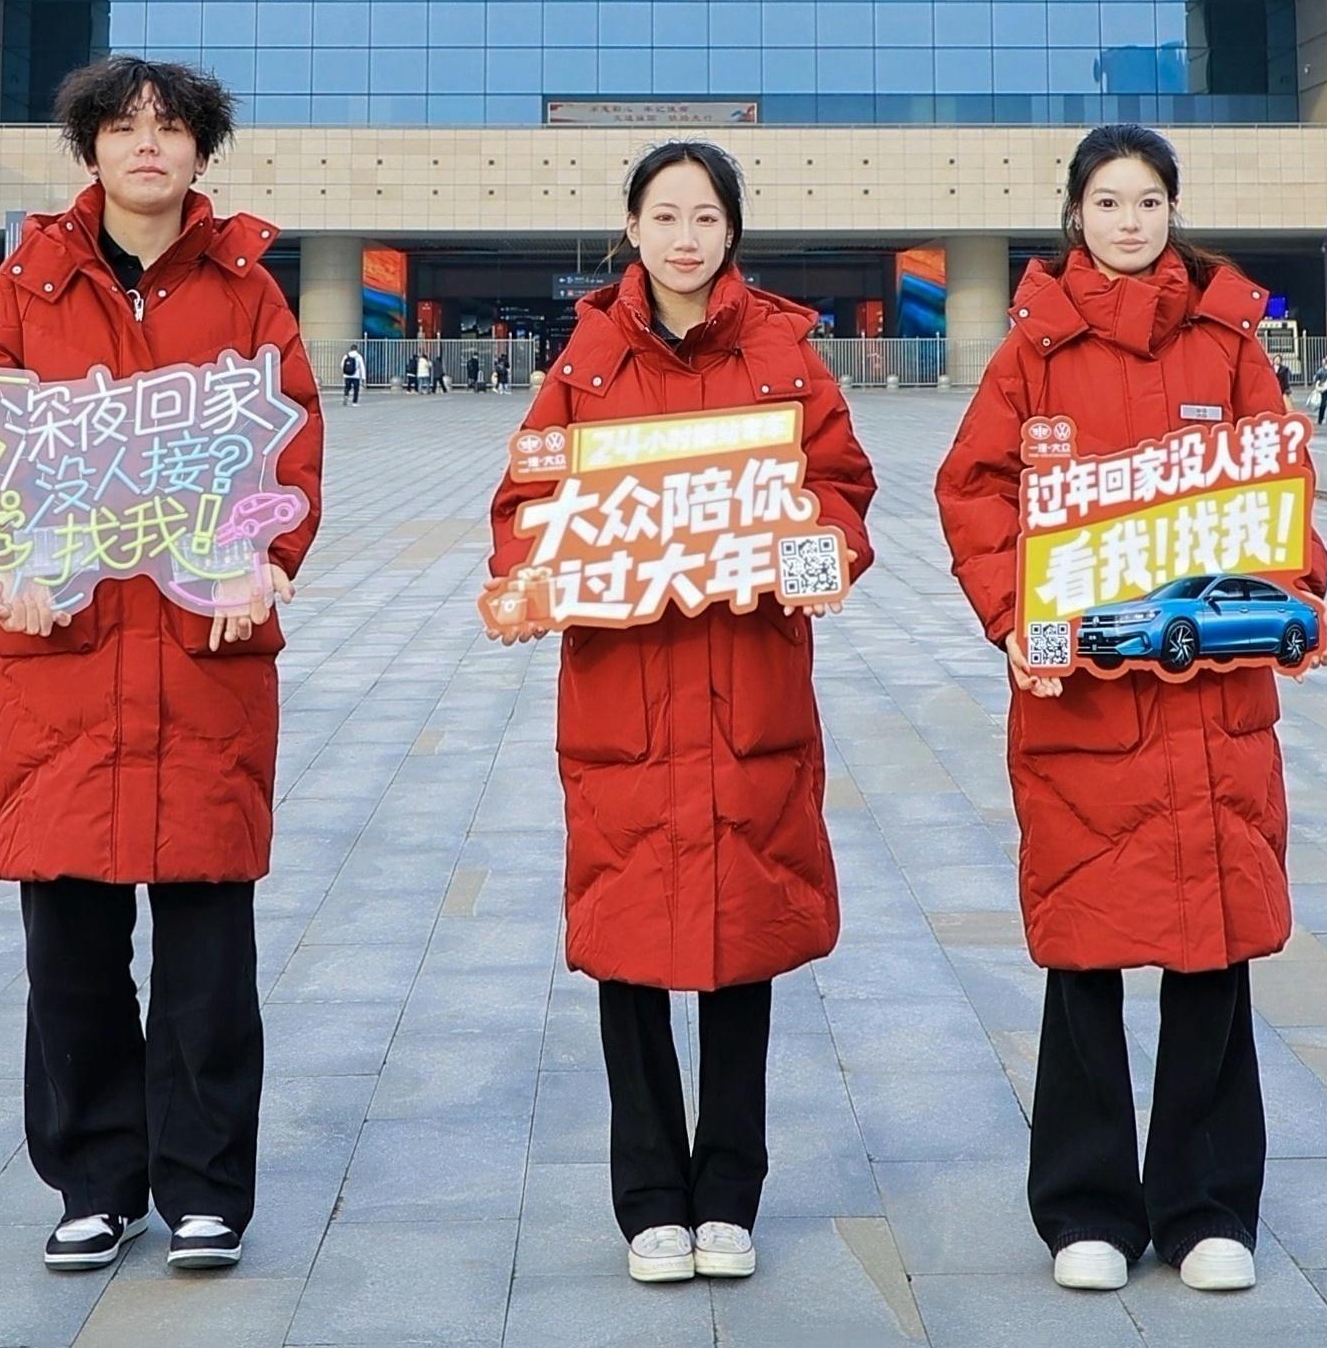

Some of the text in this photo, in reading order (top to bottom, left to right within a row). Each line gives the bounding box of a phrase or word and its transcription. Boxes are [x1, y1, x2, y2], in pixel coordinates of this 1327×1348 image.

[0, 357, 274, 490] 深夜回家
[1027, 420, 1305, 530] 过年回家没人接?
[25, 429, 253, 532] 没人接?
[520, 457, 813, 566] 大众陪你
[34, 492, 247, 587] 找我!
[550, 531, 776, 620] 过大年
[1035, 490, 1296, 617] 看我!找我!
